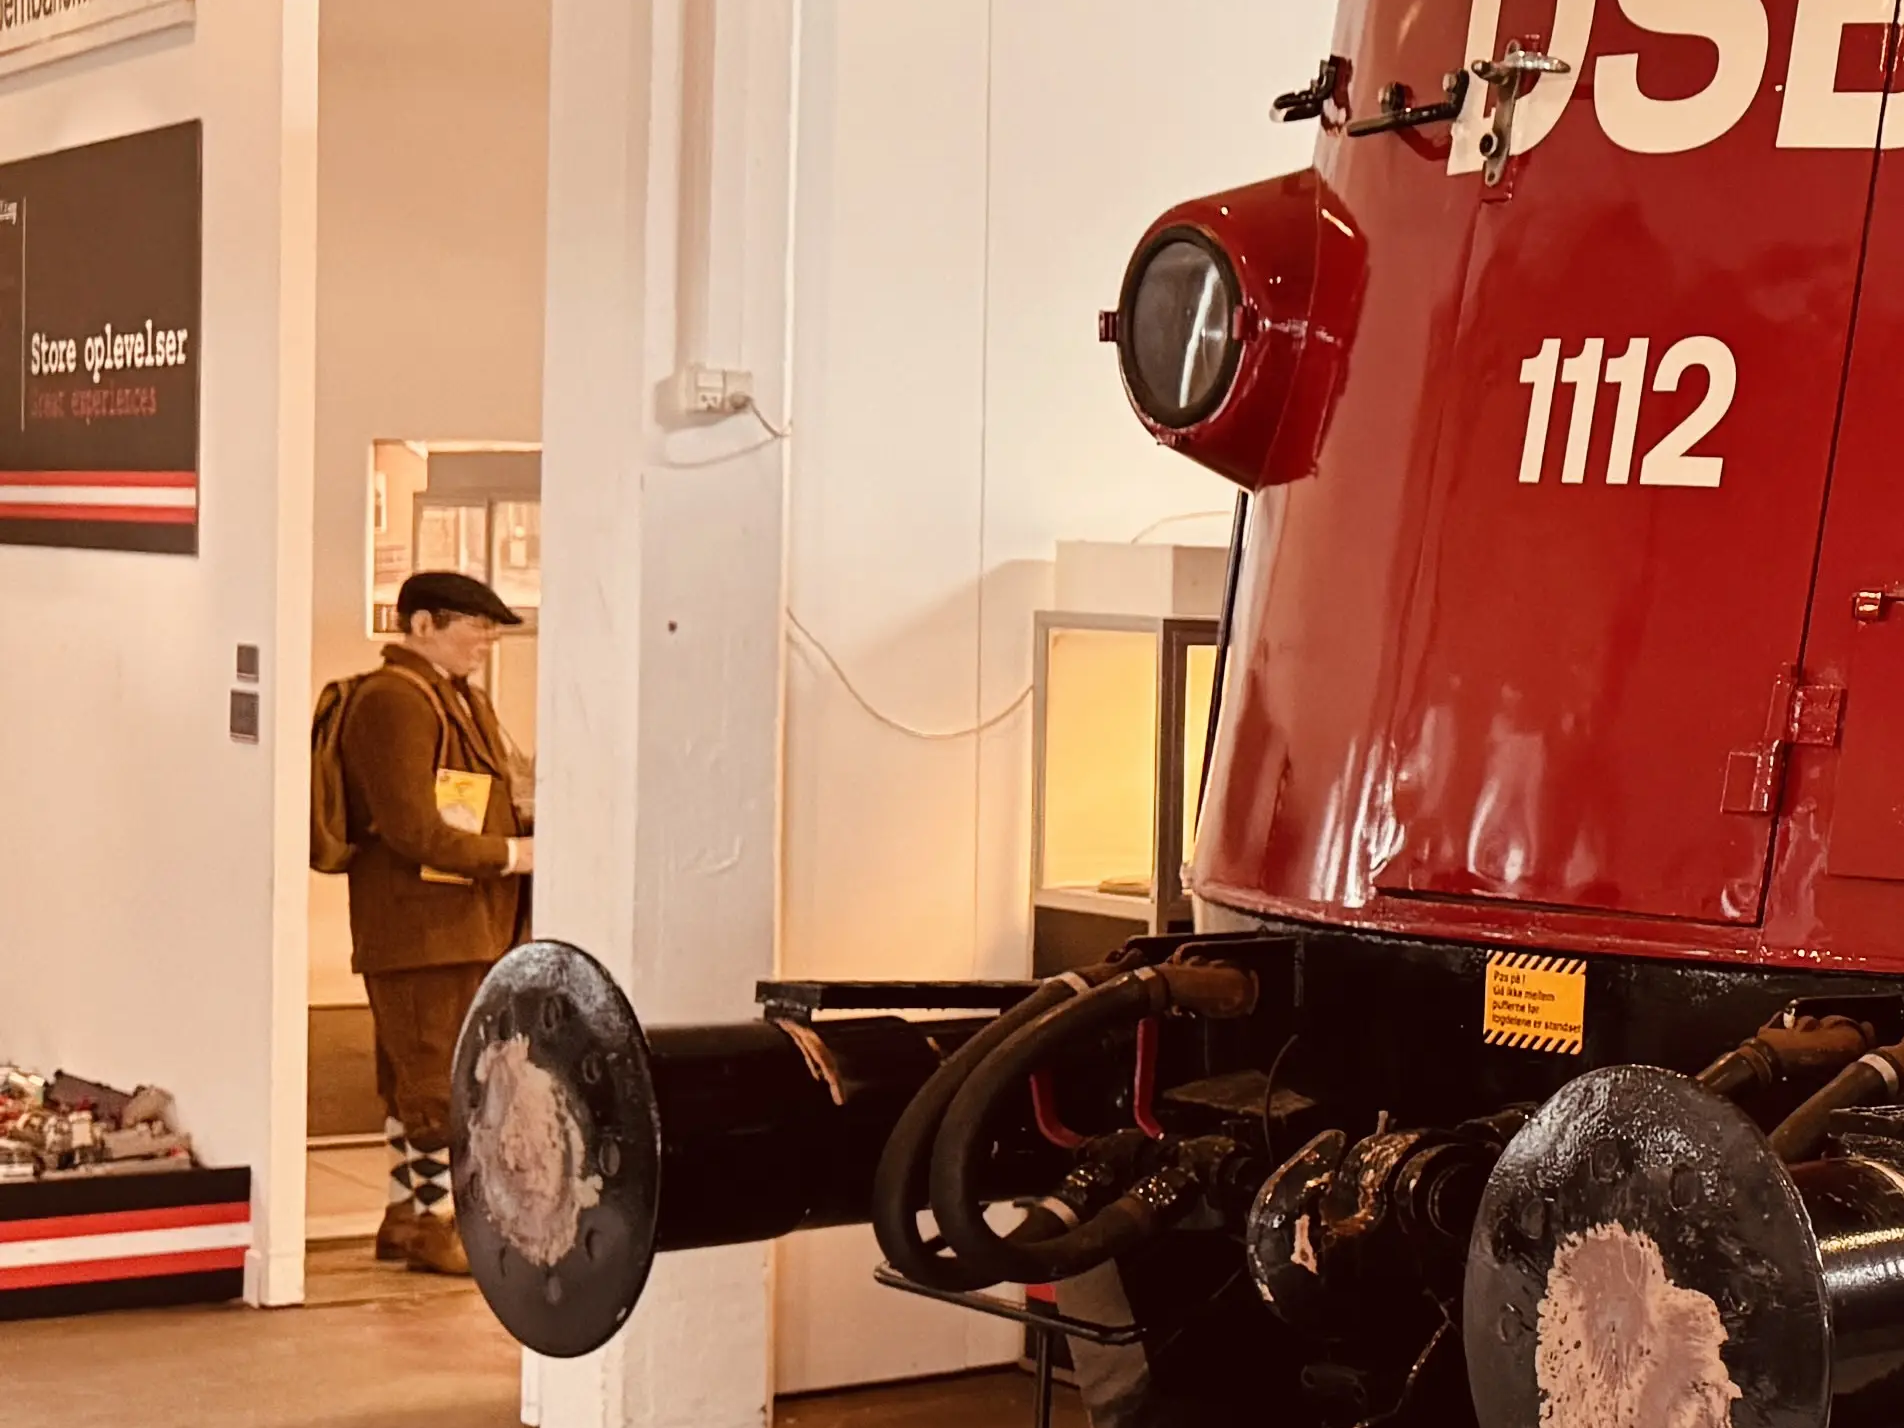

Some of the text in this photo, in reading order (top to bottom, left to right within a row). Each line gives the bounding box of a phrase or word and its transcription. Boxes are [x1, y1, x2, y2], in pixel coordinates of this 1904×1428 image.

[31, 319, 188, 383] Store oplevelser
[1518, 335, 1737, 487] 1112
